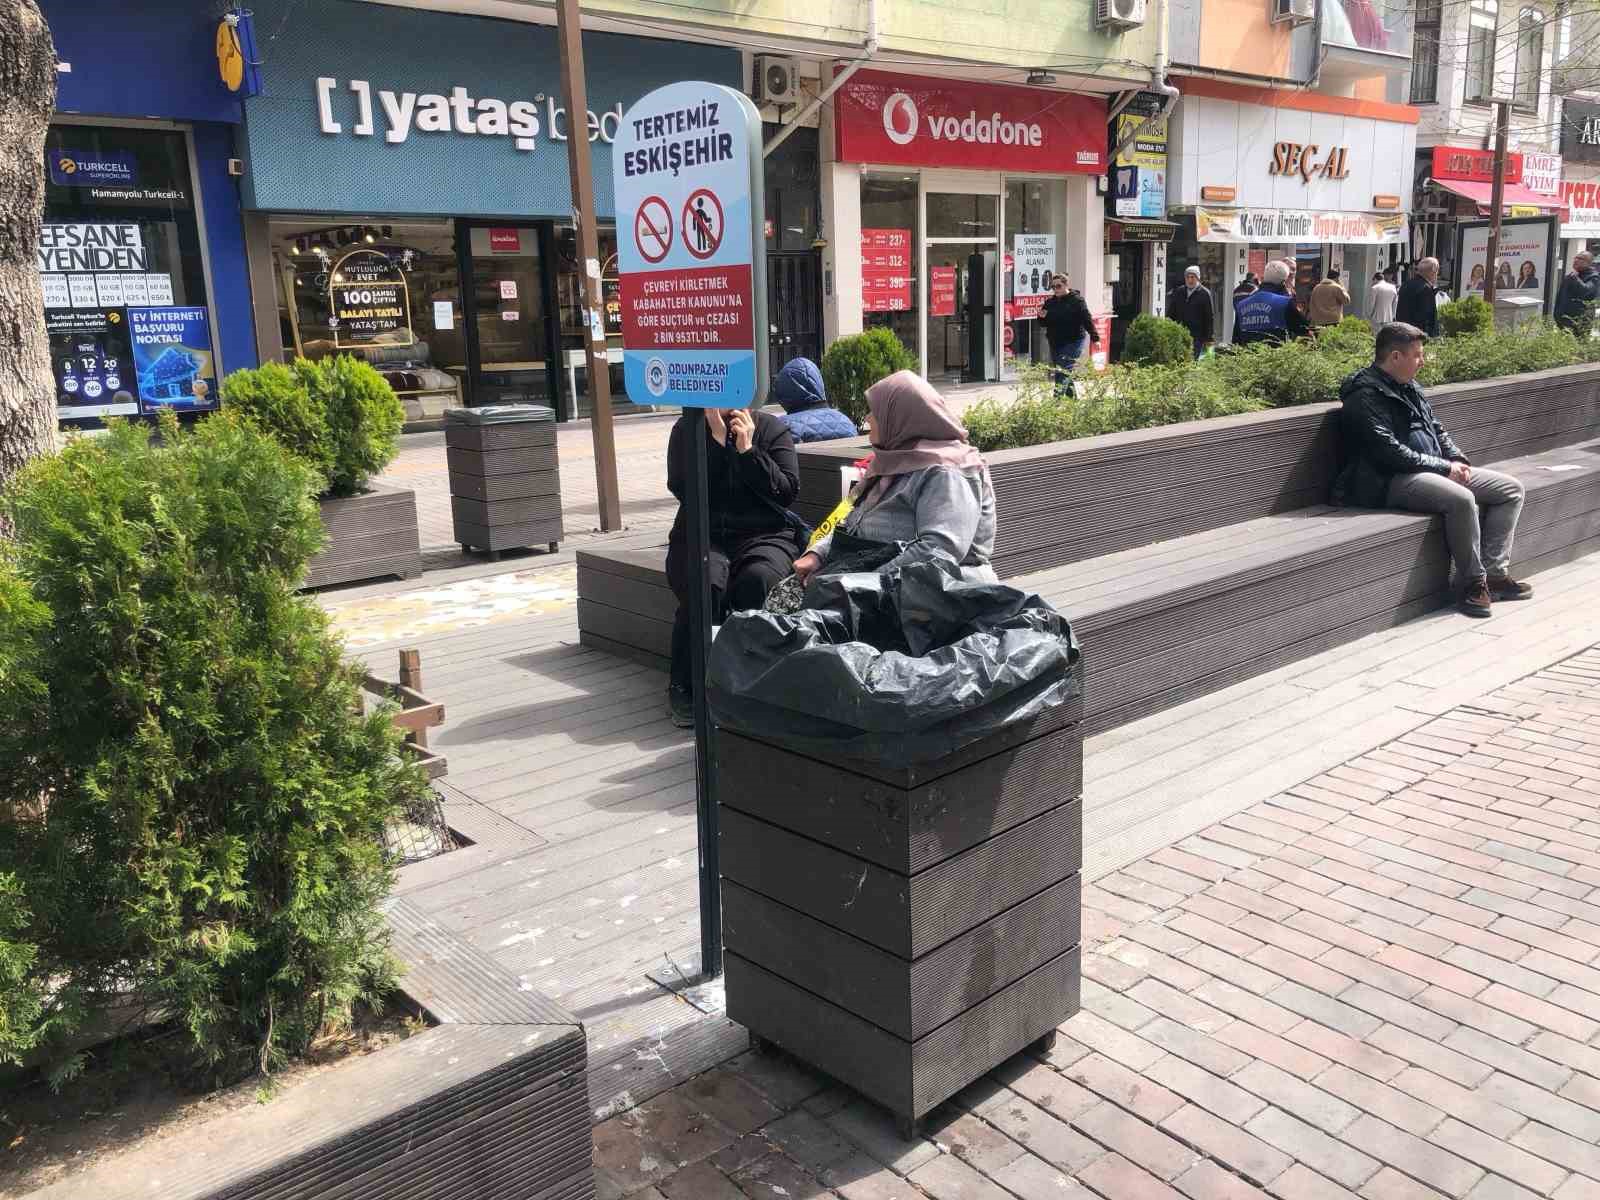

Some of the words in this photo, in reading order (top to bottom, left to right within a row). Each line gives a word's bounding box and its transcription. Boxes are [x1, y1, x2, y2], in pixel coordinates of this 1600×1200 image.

[632, 100, 720, 141] TERTEMİZ
[928, 110, 1042, 146] vodafone
[624, 129, 733, 177] ESKİŞEHİR
[76, 162, 130, 172] TURKCELL
[1525, 155, 1556, 171] EMRE
[92, 189, 142, 199] Hamamyolu
[143, 190, 185, 199] Turkcell-1
[1240, 213, 1274, 236] Kaliteli
[39, 225, 137, 248] EFSANE
[38, 245, 147, 271] YENİDEN
[889, 255, 903, 267] 312
[643, 276, 678, 296] ÇEVREYİ
[680, 275, 728, 291] KİRLETMEK
[343, 291, 372, 305] 100
[633, 297, 686, 311] KABAHATLER
[688, 294, 743, 309] KANUNU'NA
[133, 312, 146, 322] EV
[340, 309, 374, 319] BALAYI
[637, 312, 658, 327] GÖRE
[661, 313, 693, 329] SUÇTUR
[695, 316, 705, 326] ve
[706, 312, 739, 325] CEZASI
[135, 323, 185, 334] BAŞVURU
[653, 332, 659, 343] 2
[660, 330, 674, 344] BİN
[82, 358, 97, 369] 12
[103, 360, 117, 369] 20
[668, 363, 728, 376] ODUNPAZARI
